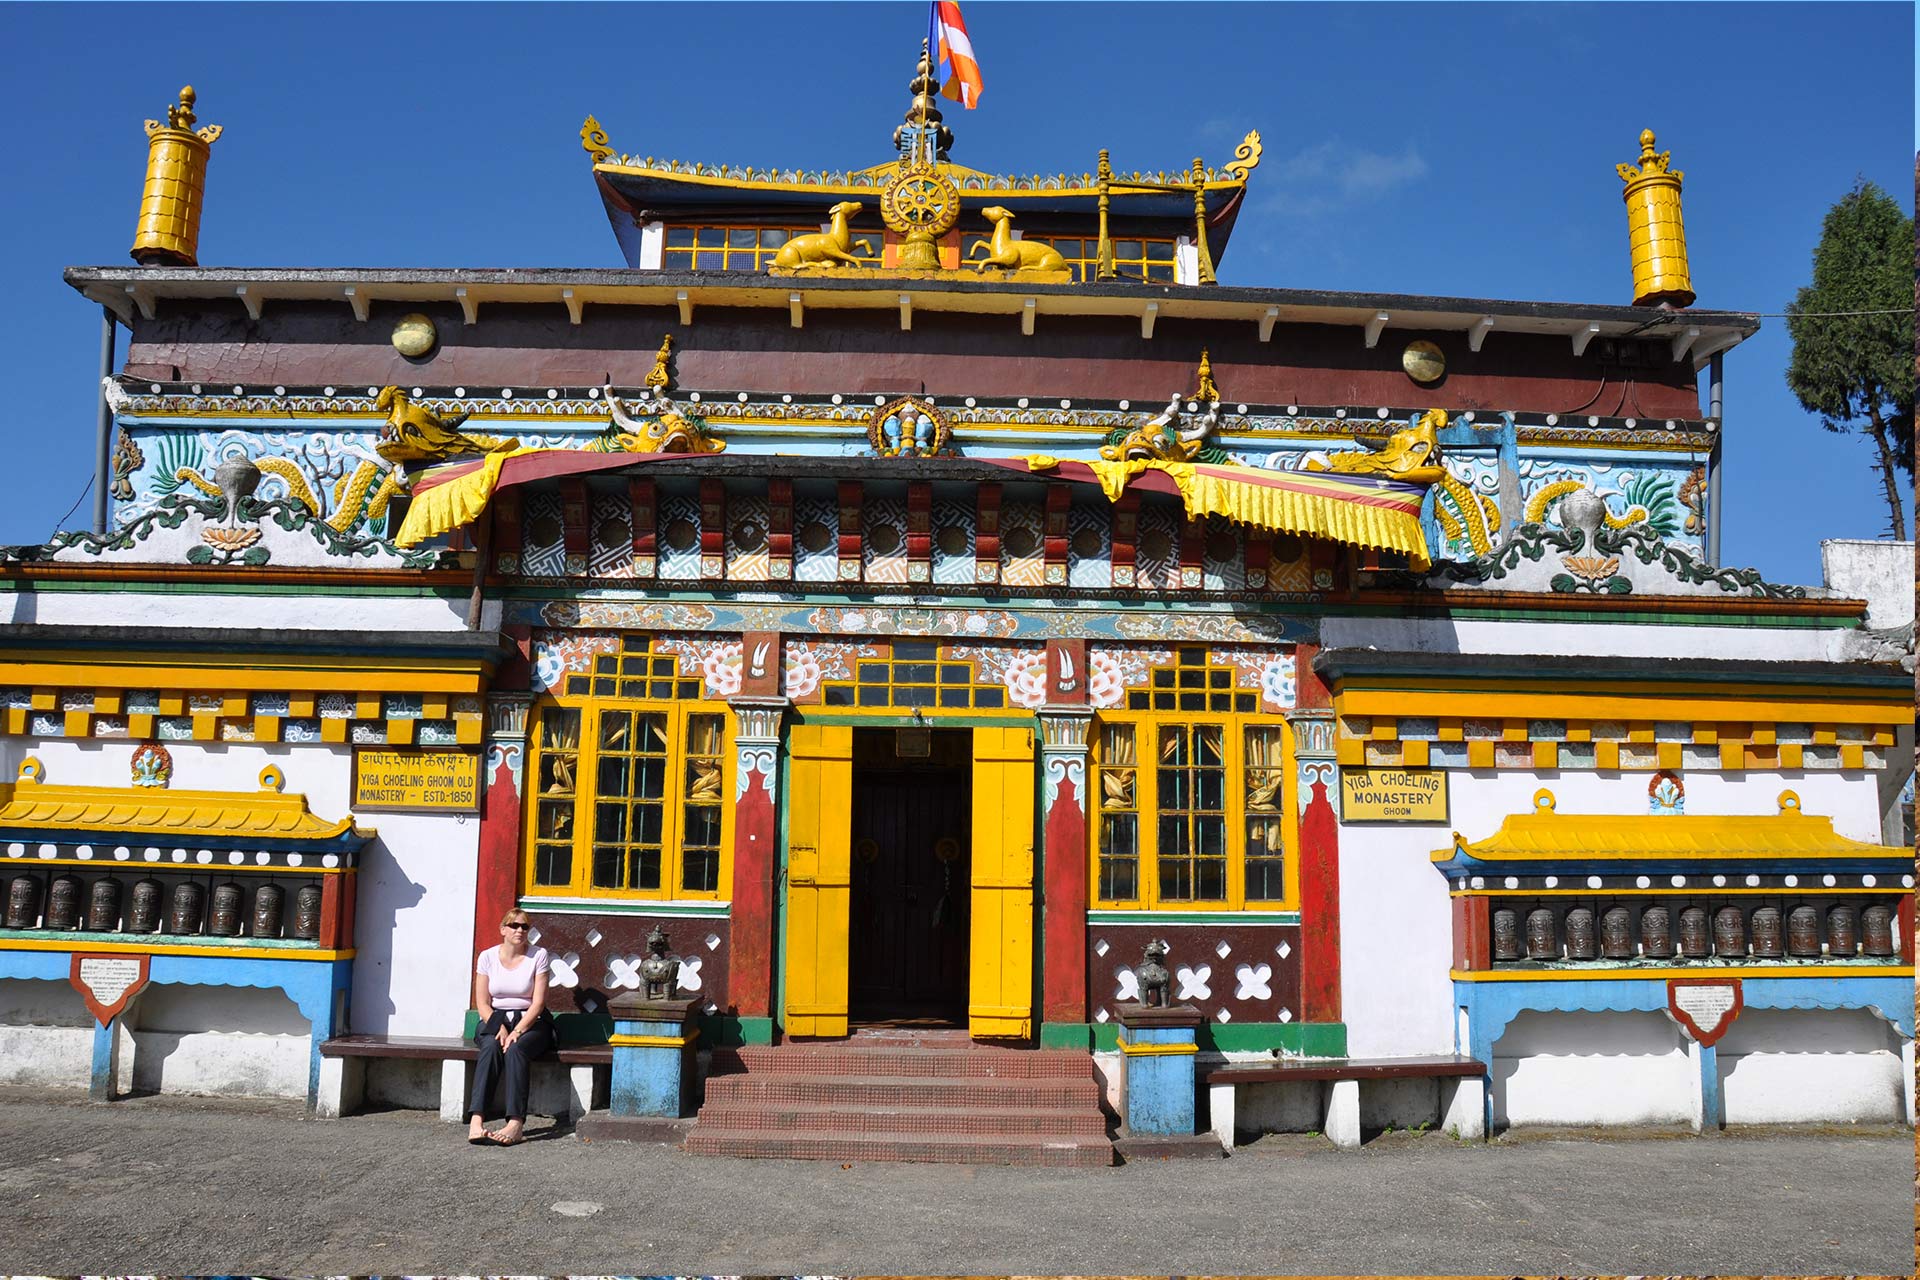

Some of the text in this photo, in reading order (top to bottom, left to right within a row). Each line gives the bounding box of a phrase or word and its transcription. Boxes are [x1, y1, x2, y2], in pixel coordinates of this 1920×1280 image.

[361, 774, 473, 788] YIGA CHOELING GHOOM OLD
[1345, 773, 1440, 792] YIGA CHOELING
[360, 789, 406, 801] MONASTERY
[1354, 792, 1434, 804] MONASTERY
